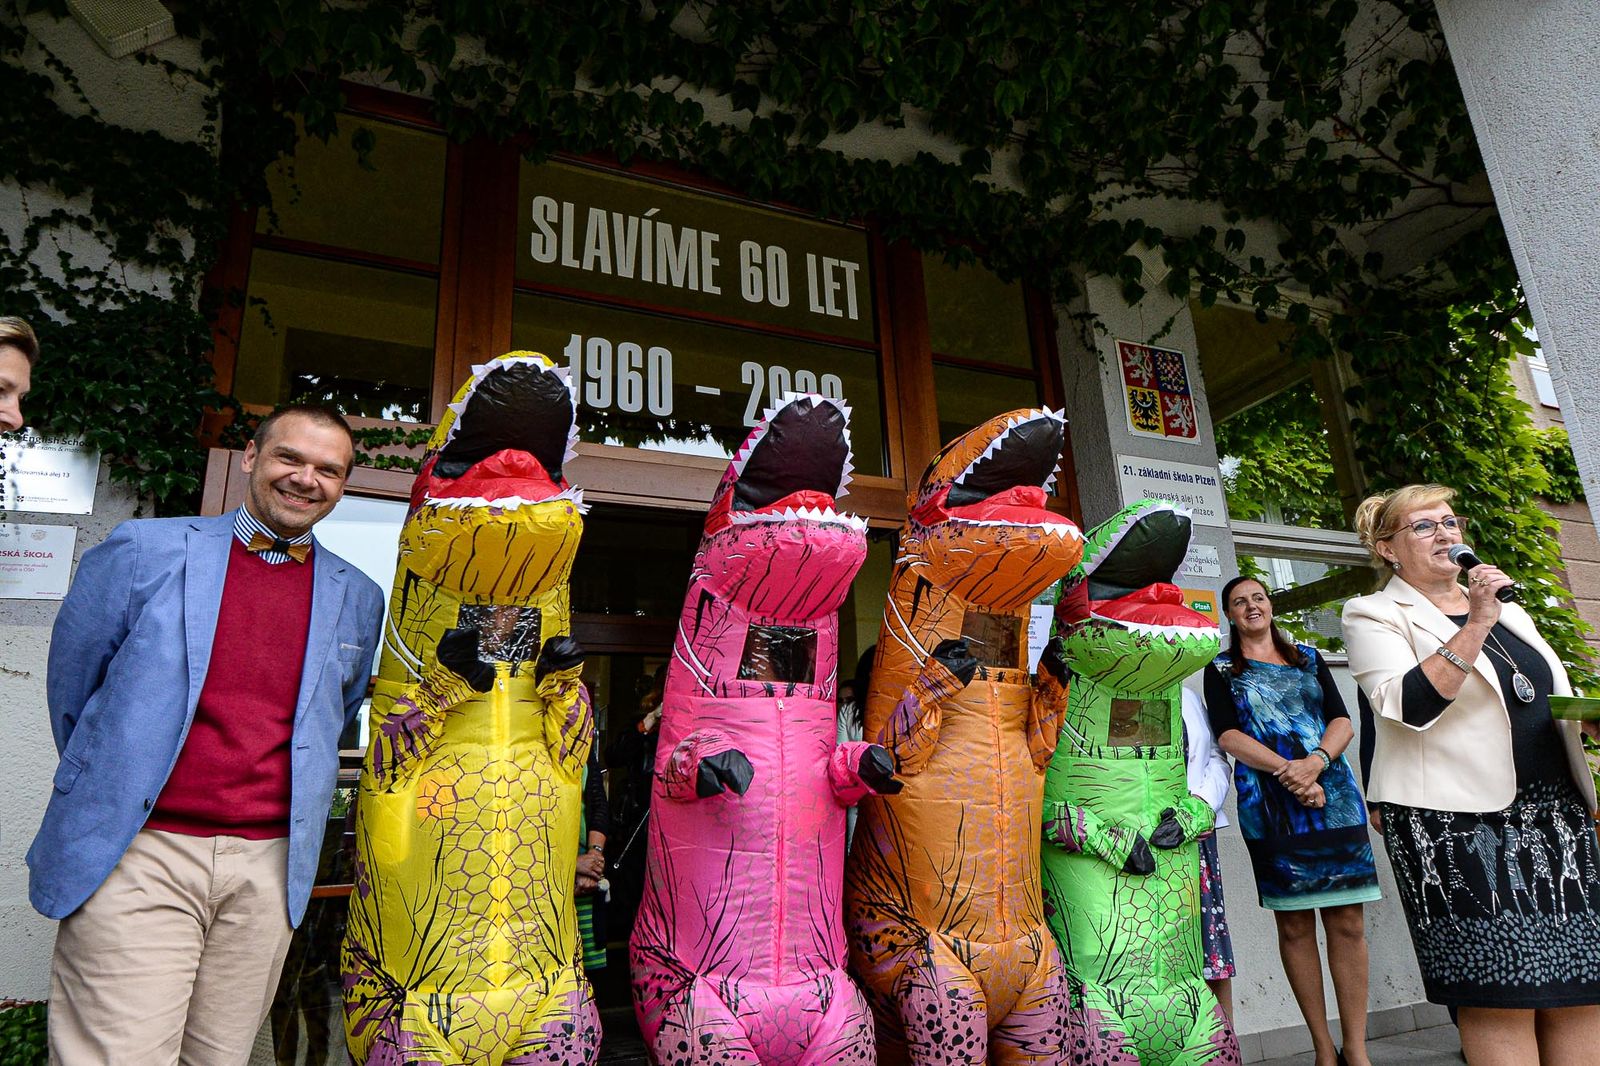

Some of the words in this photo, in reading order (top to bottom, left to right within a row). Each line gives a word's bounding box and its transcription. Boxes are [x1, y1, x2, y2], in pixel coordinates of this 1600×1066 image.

[531, 195, 722, 296] SLAVÍME
[739, 239, 790, 308] 60
[806, 252, 860, 321] LET
[563, 333, 673, 417] 1960
[22, 434, 59, 446] English
[62, 471, 71, 479] 13
[1123, 464, 1137, 478] 21.
[1138, 467, 1172, 481] základní
[1173, 471, 1194, 484] škola
[1195, 474, 1217, 487] Plzeň
[1143, 489, 1179, 502] Slovanská
[1180, 493, 1194, 505] alej
[1195, 496, 1204, 504] 13
[23, 549, 54, 559] ŠKOLA
[1193, 563, 1204, 574] ČR
[1194, 602, 1212, 611] Plzeň
